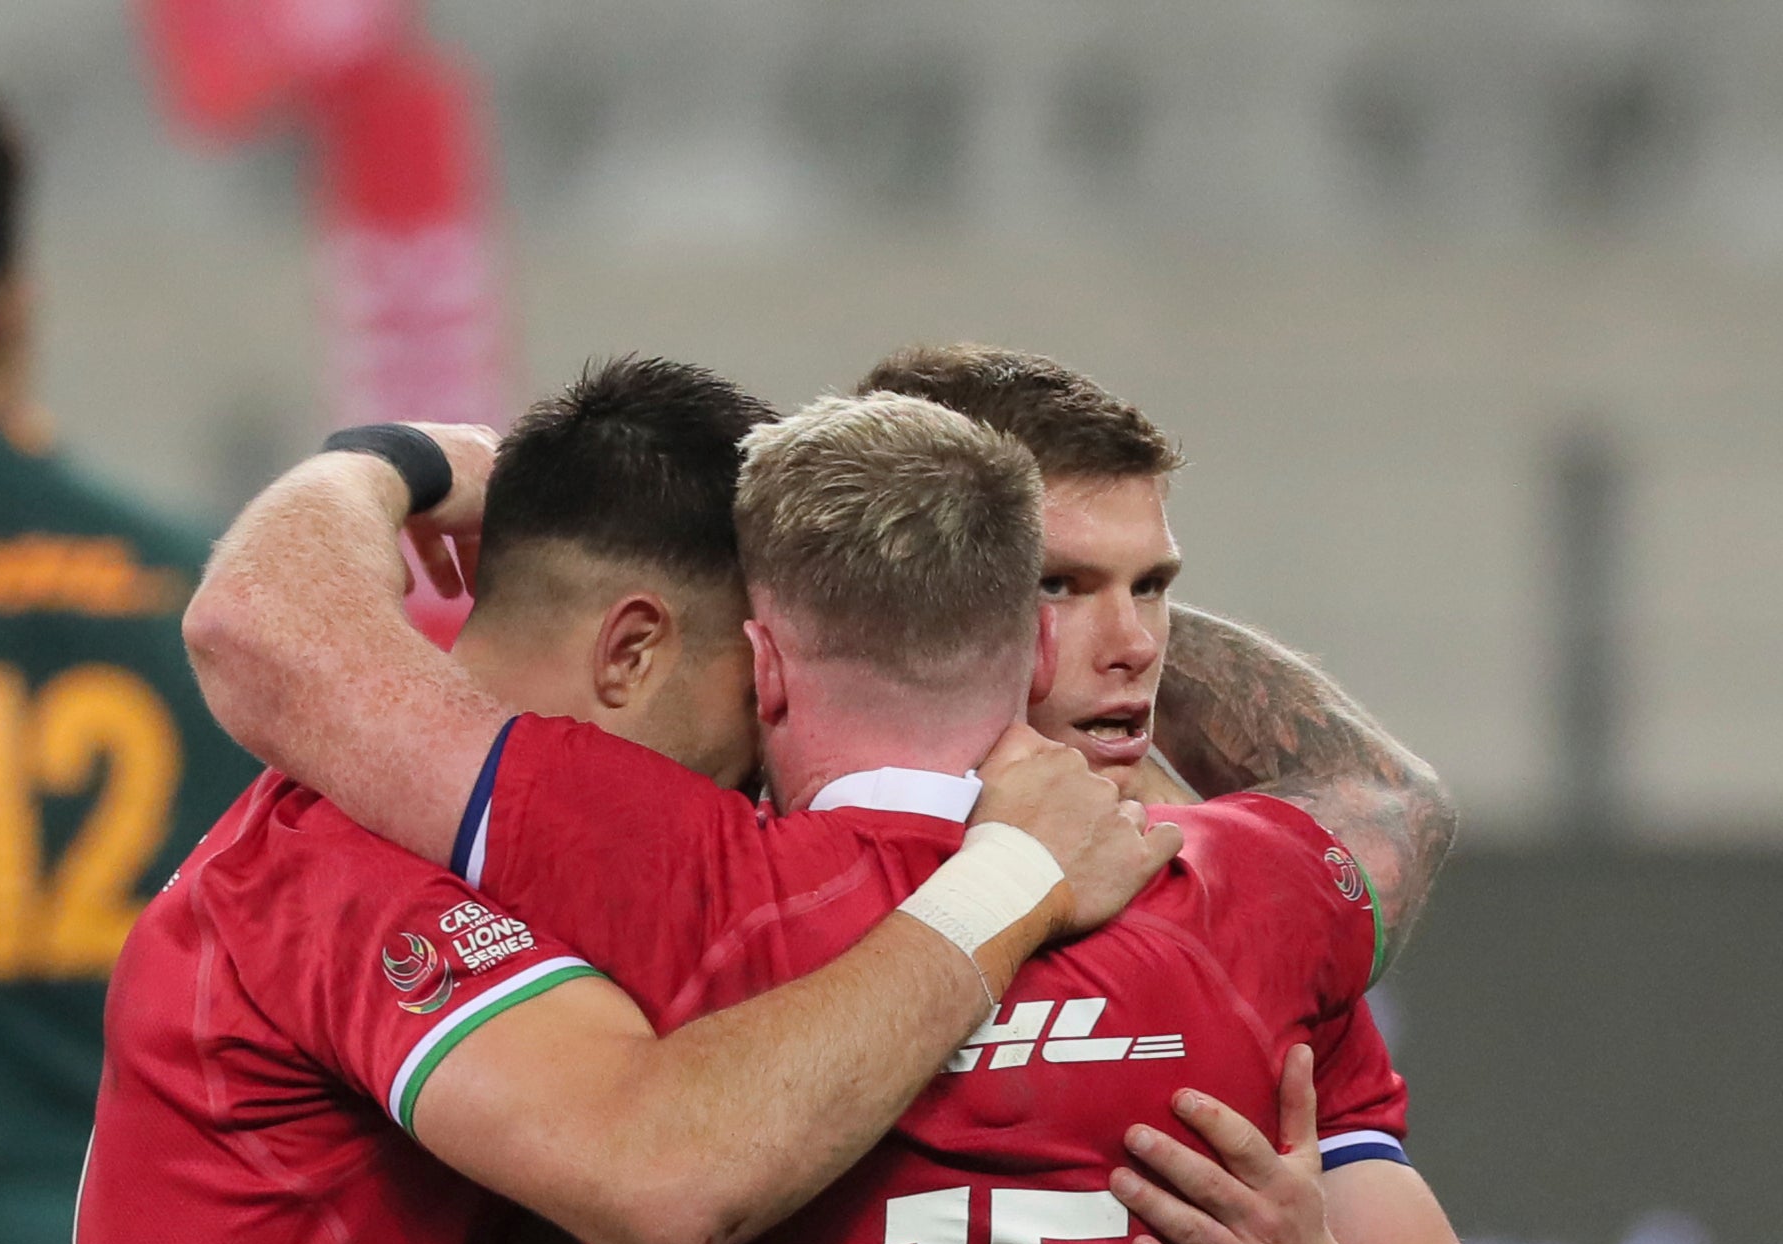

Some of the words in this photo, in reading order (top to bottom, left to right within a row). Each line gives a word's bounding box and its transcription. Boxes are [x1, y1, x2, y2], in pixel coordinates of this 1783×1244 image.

[452, 917, 527, 957] LIONS
[463, 931, 535, 969] SERIES
[937, 997, 1133, 1074] HL
